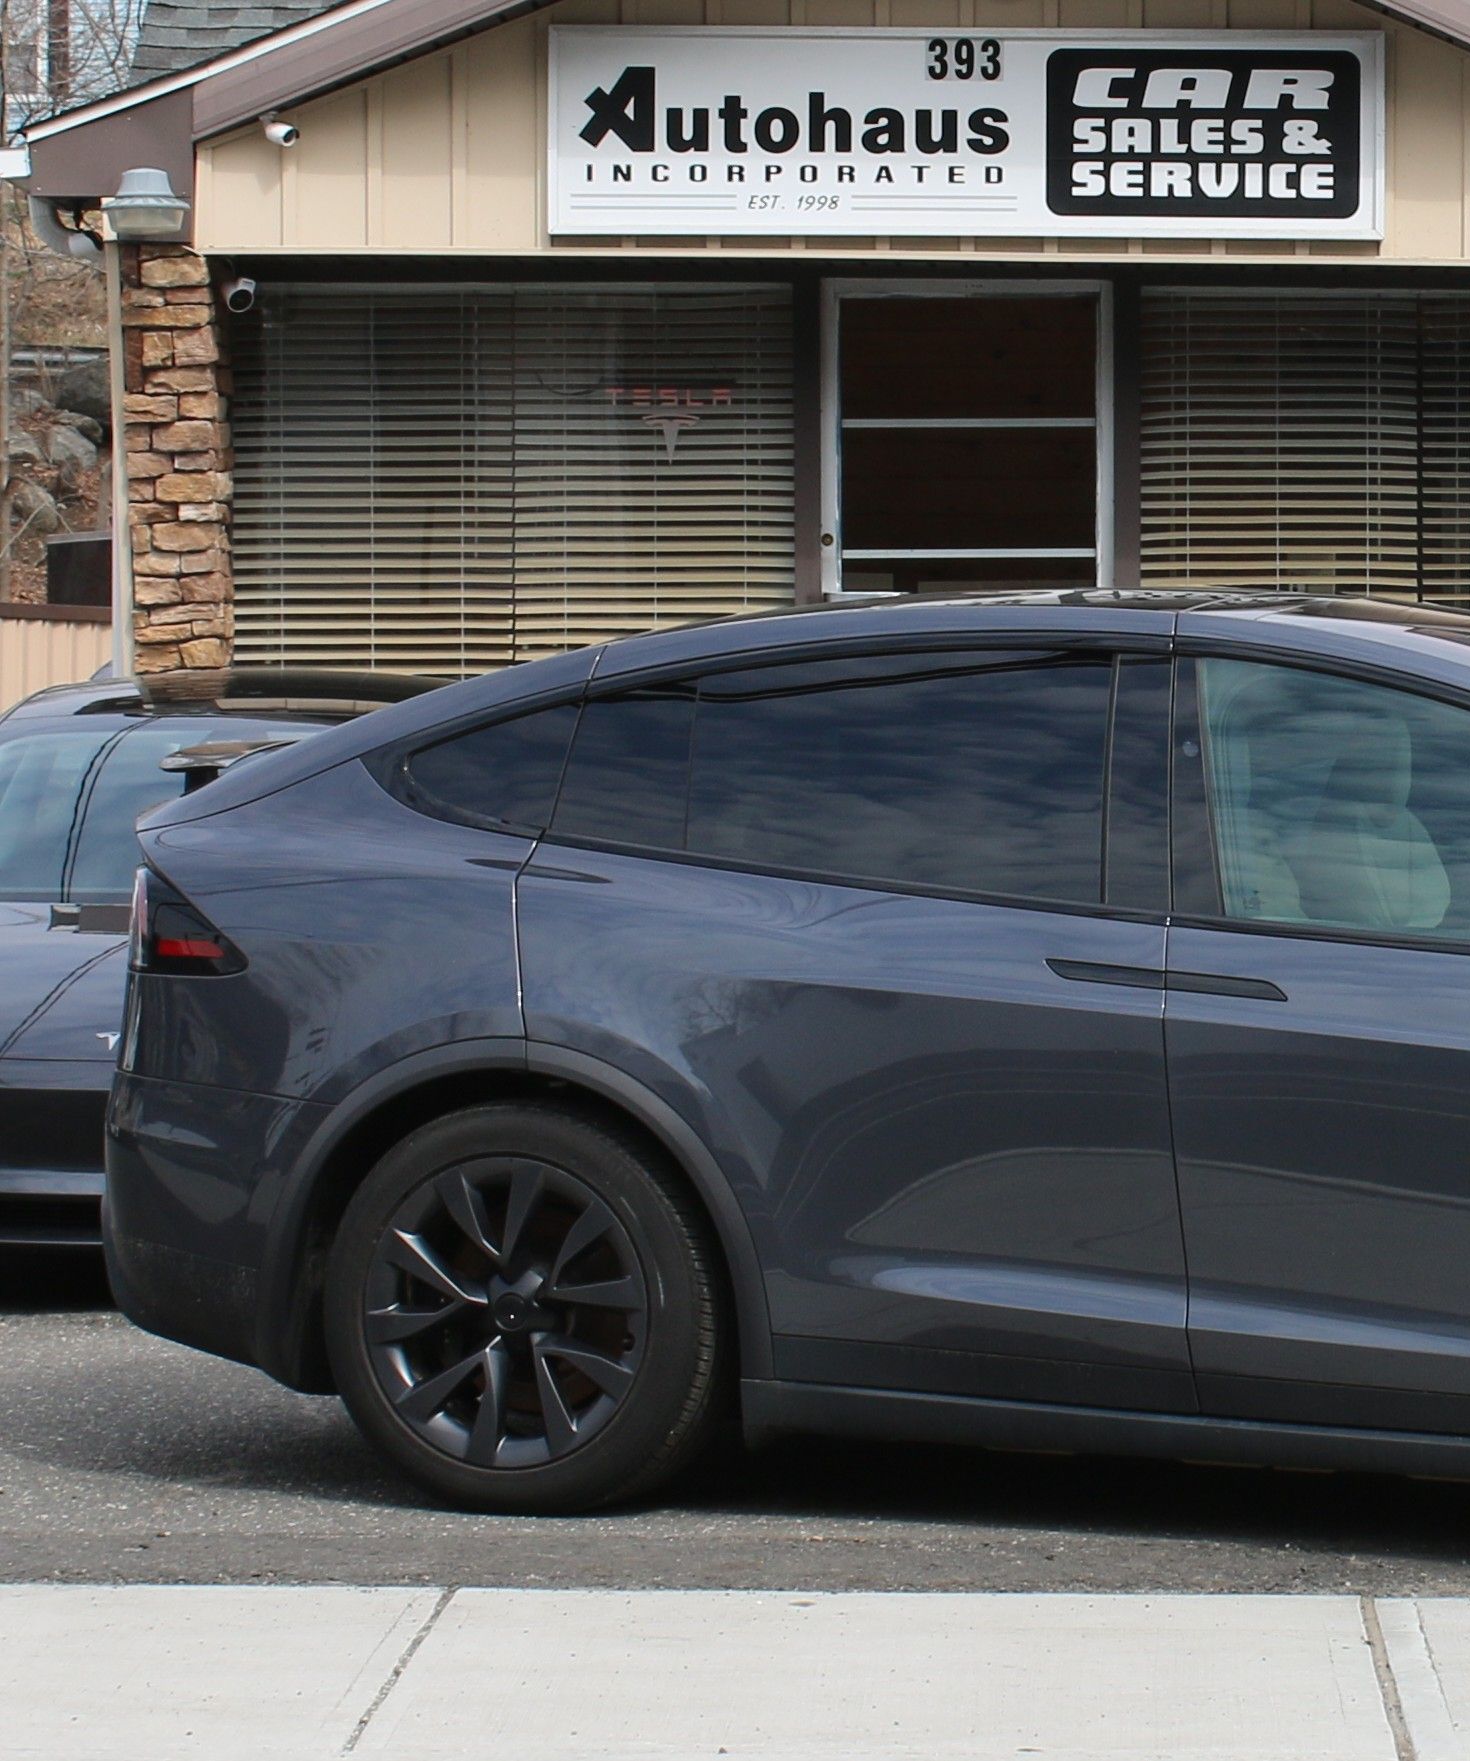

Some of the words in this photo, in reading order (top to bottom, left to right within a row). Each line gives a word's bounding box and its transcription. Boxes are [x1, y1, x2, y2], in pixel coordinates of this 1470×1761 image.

[925, 39, 1001, 80] 393
[1072, 68, 1334, 108] CAR
[578, 66, 1010, 154] Autohaus
[1073, 118, 1264, 154] SALES
[1281, 119, 1332, 155] &
[586, 164, 1003, 184] INCORPORATED
[1072, 161, 1334, 199] SERVICE
[747, 194, 785, 210] EST.
[797, 195, 840, 211] 1998
[605, 388, 732, 406] TESLA
